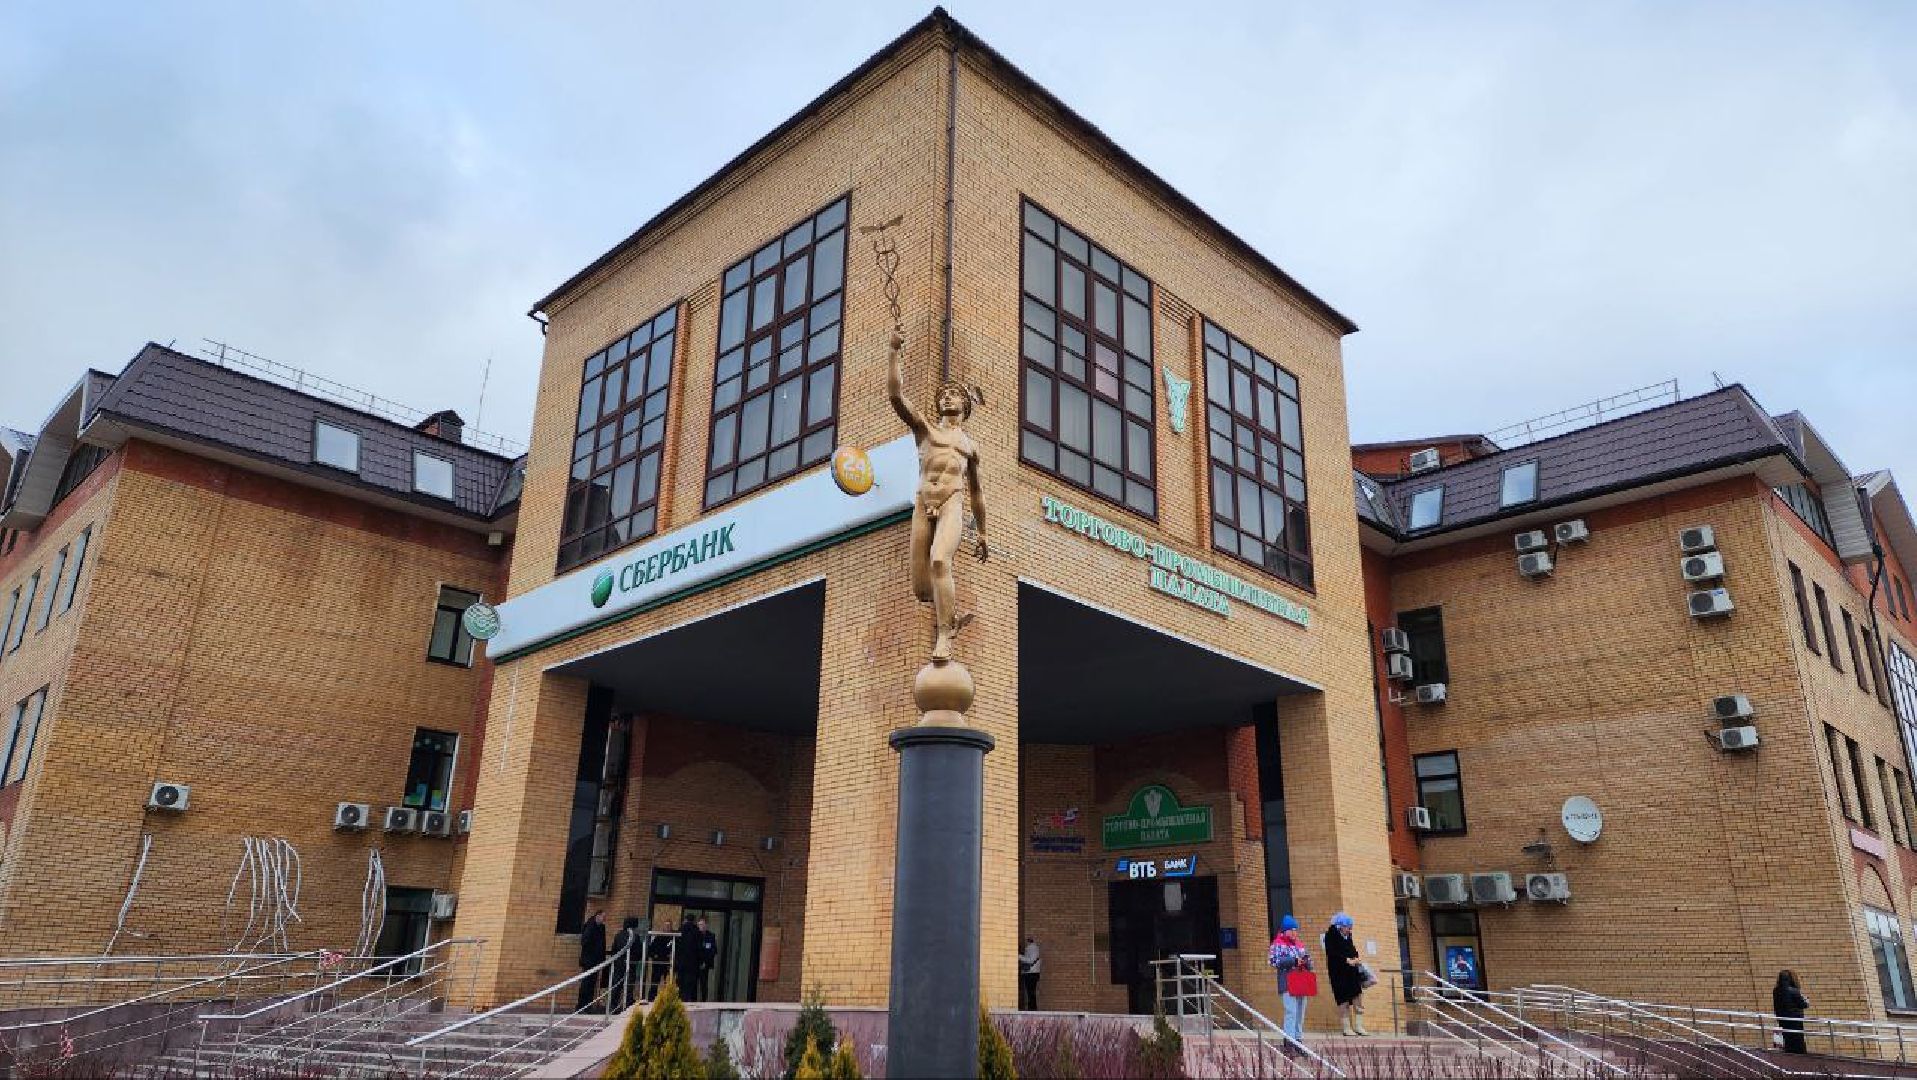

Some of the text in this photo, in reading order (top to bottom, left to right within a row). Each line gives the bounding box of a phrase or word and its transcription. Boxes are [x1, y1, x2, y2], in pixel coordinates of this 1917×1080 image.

[619, 521, 736, 592] СБЕРБАНК
[1149, 565, 1230, 617] ПАЛАТА
[1129, 858, 1188, 878] ВТБ БАНК
